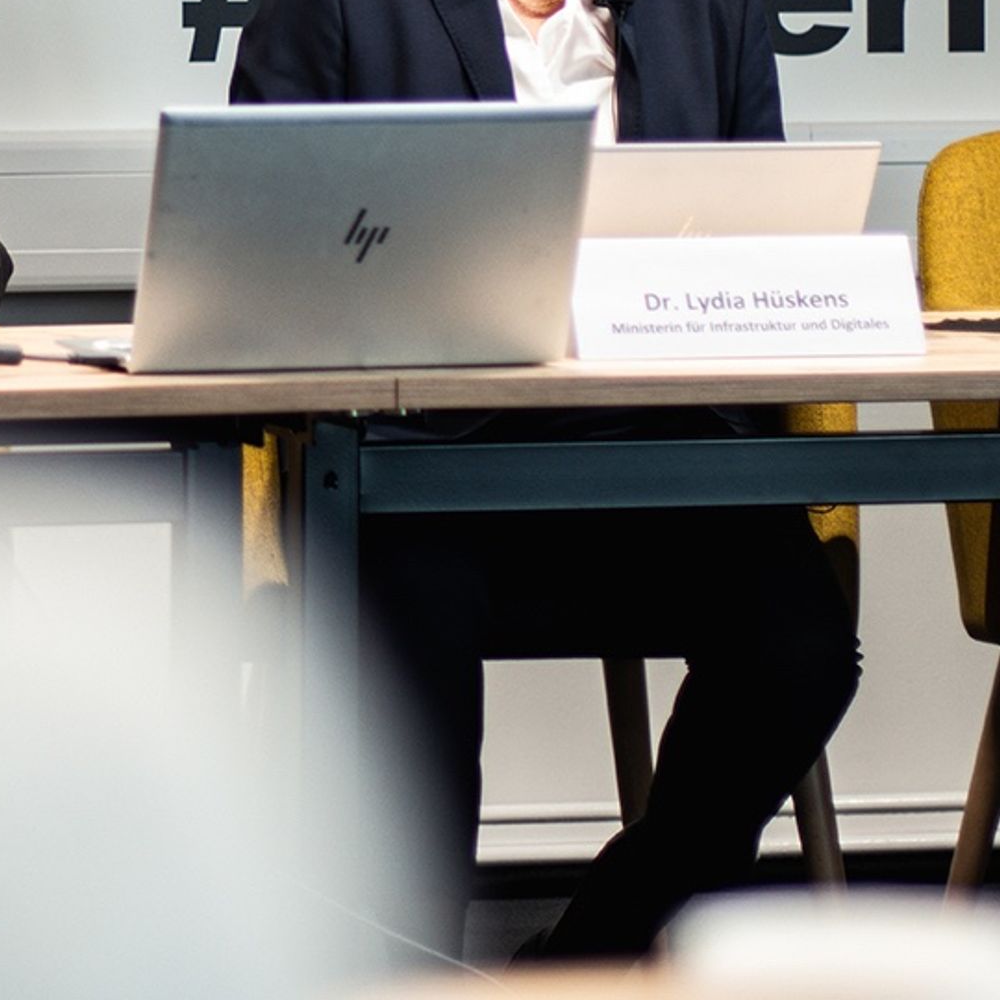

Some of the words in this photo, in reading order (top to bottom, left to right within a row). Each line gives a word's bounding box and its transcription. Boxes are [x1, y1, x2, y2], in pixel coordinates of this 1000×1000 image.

[643, 292, 679, 312] Dr.
[685, 290, 746, 315] Lydia
[751, 289, 849, 309] Hüskens
[611, 322, 683, 335] Ministerin
[685, 321, 705, 334] für
[709, 319, 796, 333] Infrastruktur
[800, 319, 828, 332] und
[830, 318, 890, 334] Digitales
